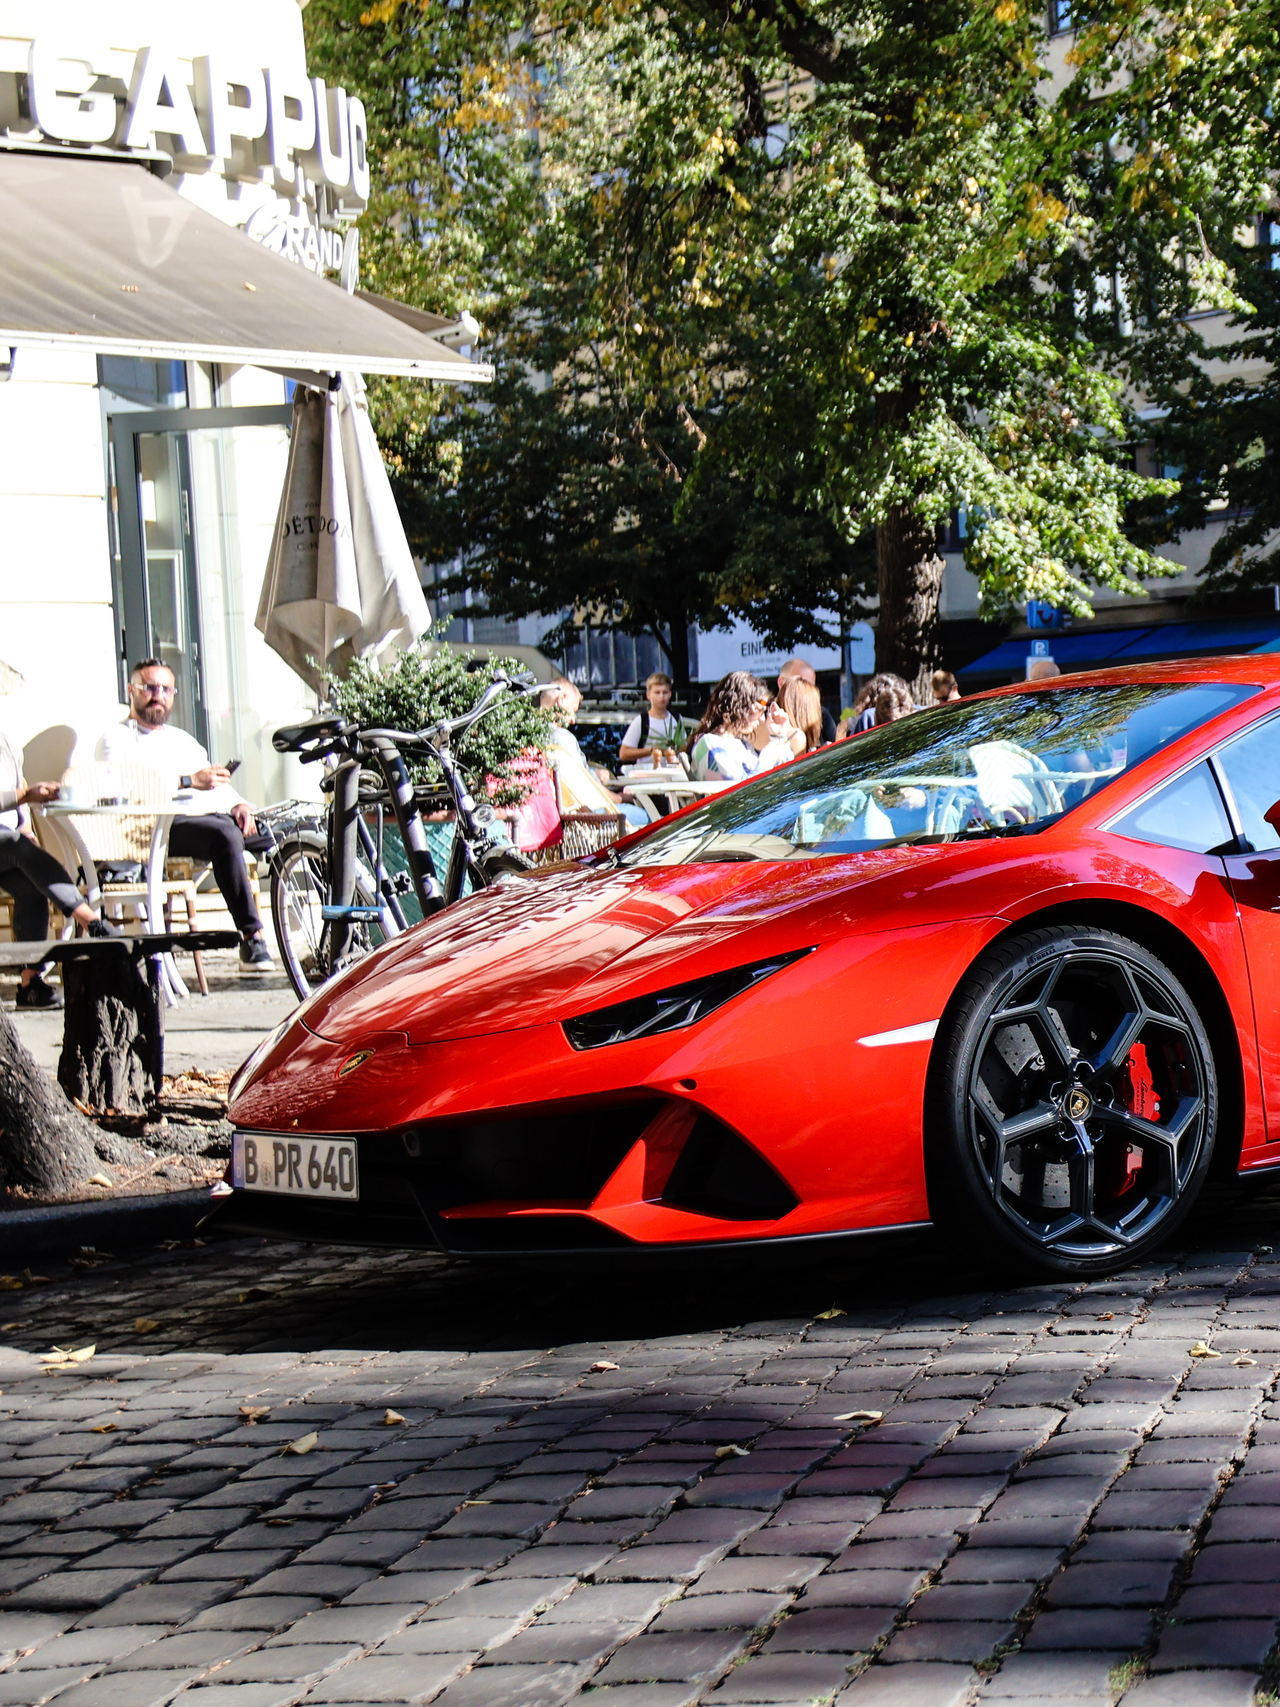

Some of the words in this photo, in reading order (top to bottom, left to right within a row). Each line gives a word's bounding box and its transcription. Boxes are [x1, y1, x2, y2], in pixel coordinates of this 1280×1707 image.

[244, 1140, 258, 1184] B
[272, 1141, 303, 1189] PR
[308, 1145, 355, 1192] 640
